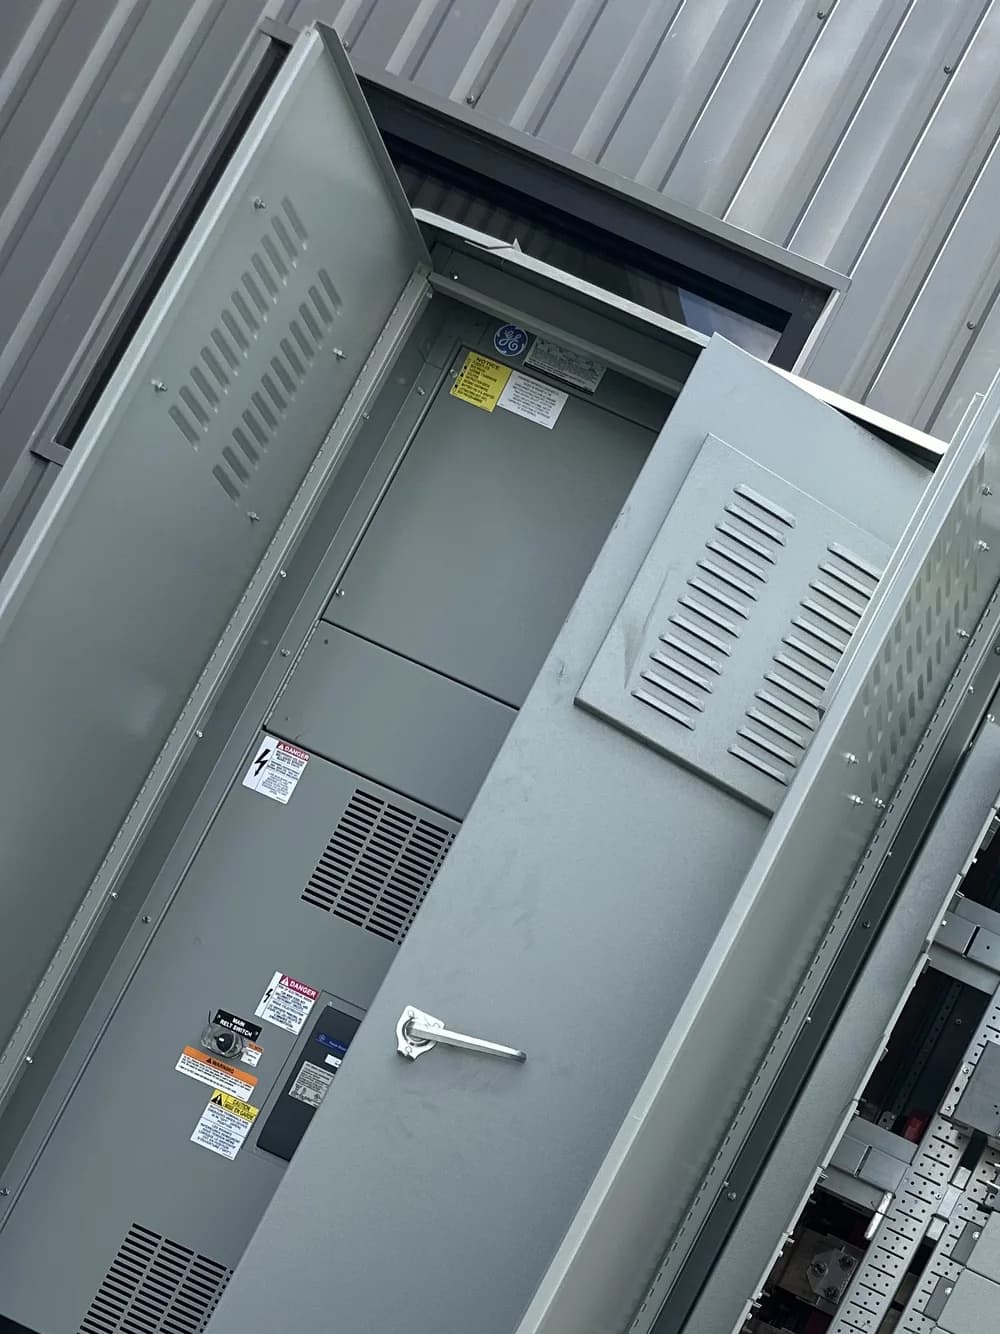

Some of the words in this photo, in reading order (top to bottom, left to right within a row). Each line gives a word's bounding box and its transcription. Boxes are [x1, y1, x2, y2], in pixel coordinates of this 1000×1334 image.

[475, 356, 499, 370] NOTICE
[283, 745, 309, 760] DANGER
[288, 979, 316, 997] DANGER
[231, 1017, 246, 1027] MAIN
[232, 1024, 253, 1037] SWITCH
[211, 1059, 234, 1073] WARNING
[232, 1099, 250, 1111] CAUTION
